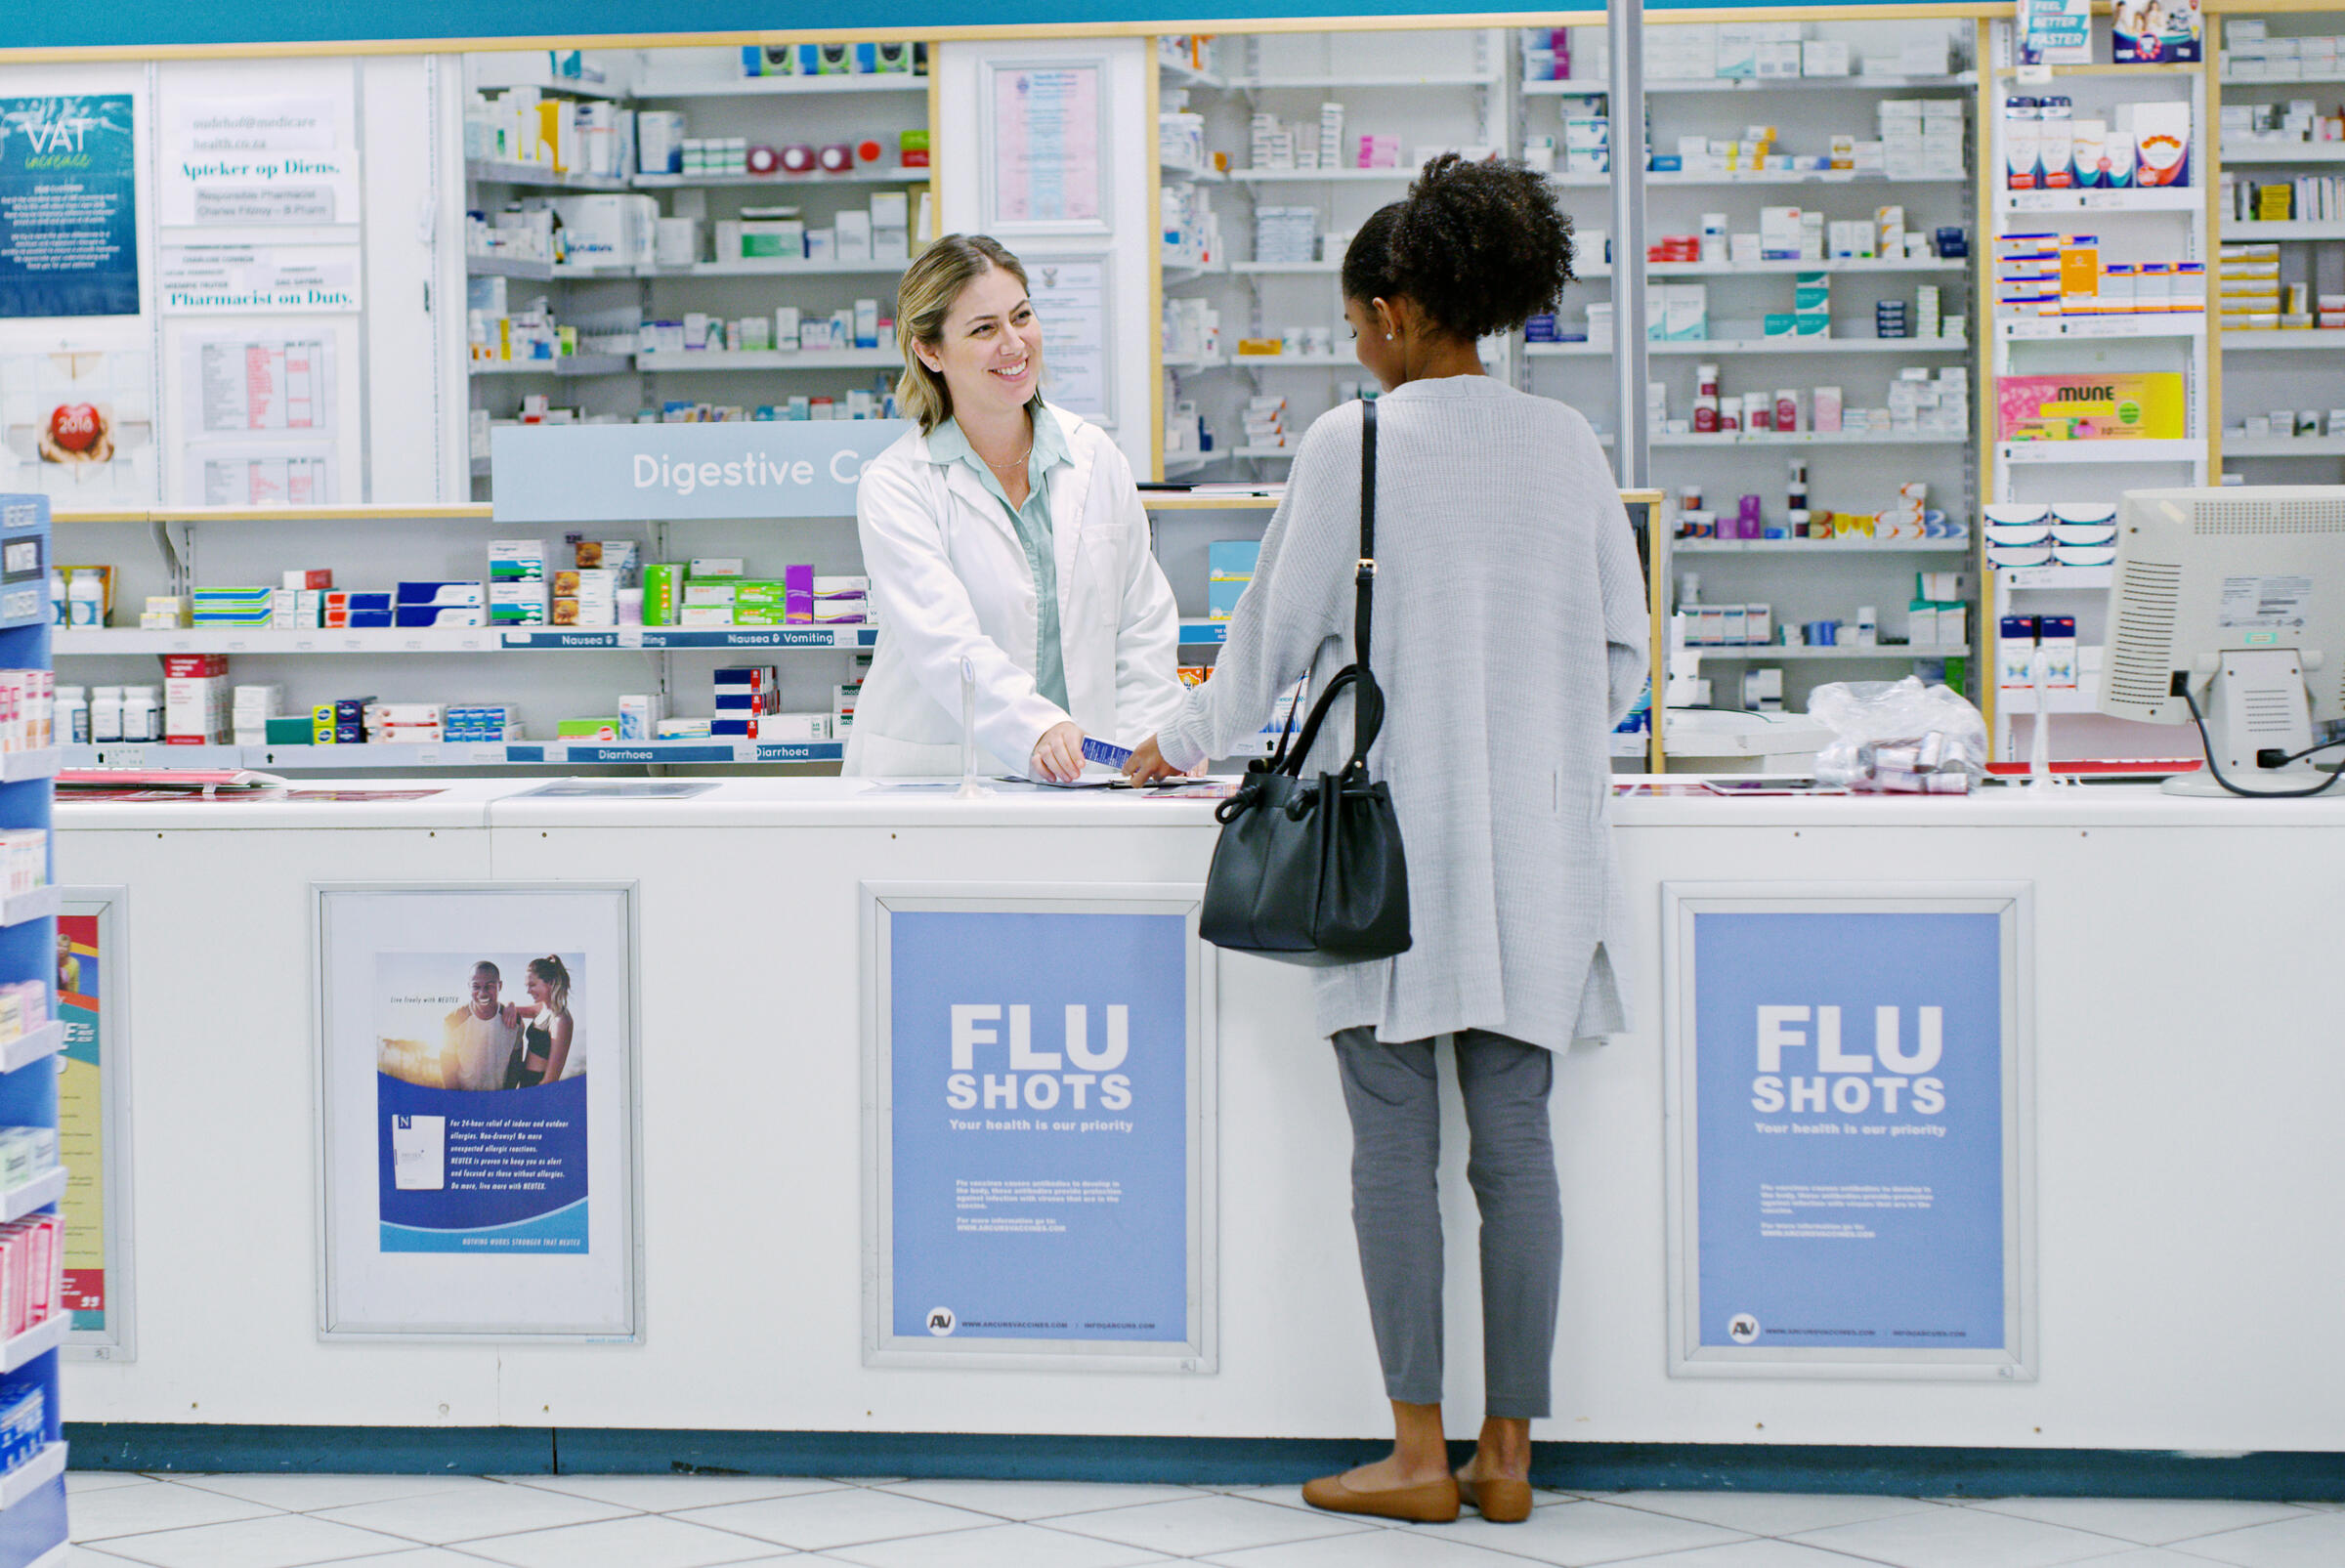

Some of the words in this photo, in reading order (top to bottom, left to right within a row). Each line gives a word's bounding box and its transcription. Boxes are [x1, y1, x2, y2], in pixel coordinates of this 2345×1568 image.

[2031, 17, 2077, 27] BETTER
[2030, 33, 2083, 45] FASTER
[24, 118, 92, 153] VAT
[181, 161, 249, 181] Apteker
[256, 165, 277, 179] op
[285, 158, 340, 175] Diens.
[171, 289, 272, 305] Pharmacist
[278, 294, 301, 305] on
[308, 289, 352, 308] Duty.
[634, 451, 814, 495] Digestive
[562, 635, 603, 645] Nausea
[606, 634, 614, 645] &
[728, 634, 770, 644] Nausea
[773, 633, 780, 643] &
[784, 633, 833, 644] Vomiting
[598, 749, 653, 760] Diarrhoea
[756, 746, 809, 757] Diarrhoea
[950, 1003, 1130, 1072] FLU
[1757, 1005, 1942, 1075] FLU
[946, 1074, 1132, 1111] SHOTS
[1751, 1076, 1945, 1114] SHOTS
[400, 1117, 409, 1126] N
[950, 1120, 981, 1130] Your
[986, 1120, 1031, 1130] health
[1036, 1120, 1048, 1130] is
[1053, 1120, 1076, 1130] our
[1081, 1121, 1133, 1133] priority
[1755, 1123, 1788, 1133] Your
[1792, 1123, 1840, 1134] health
[1844, 1123, 1857, 1134] is
[1862, 1125, 1887, 1134] our
[1890, 1124, 1946, 1137] priority
